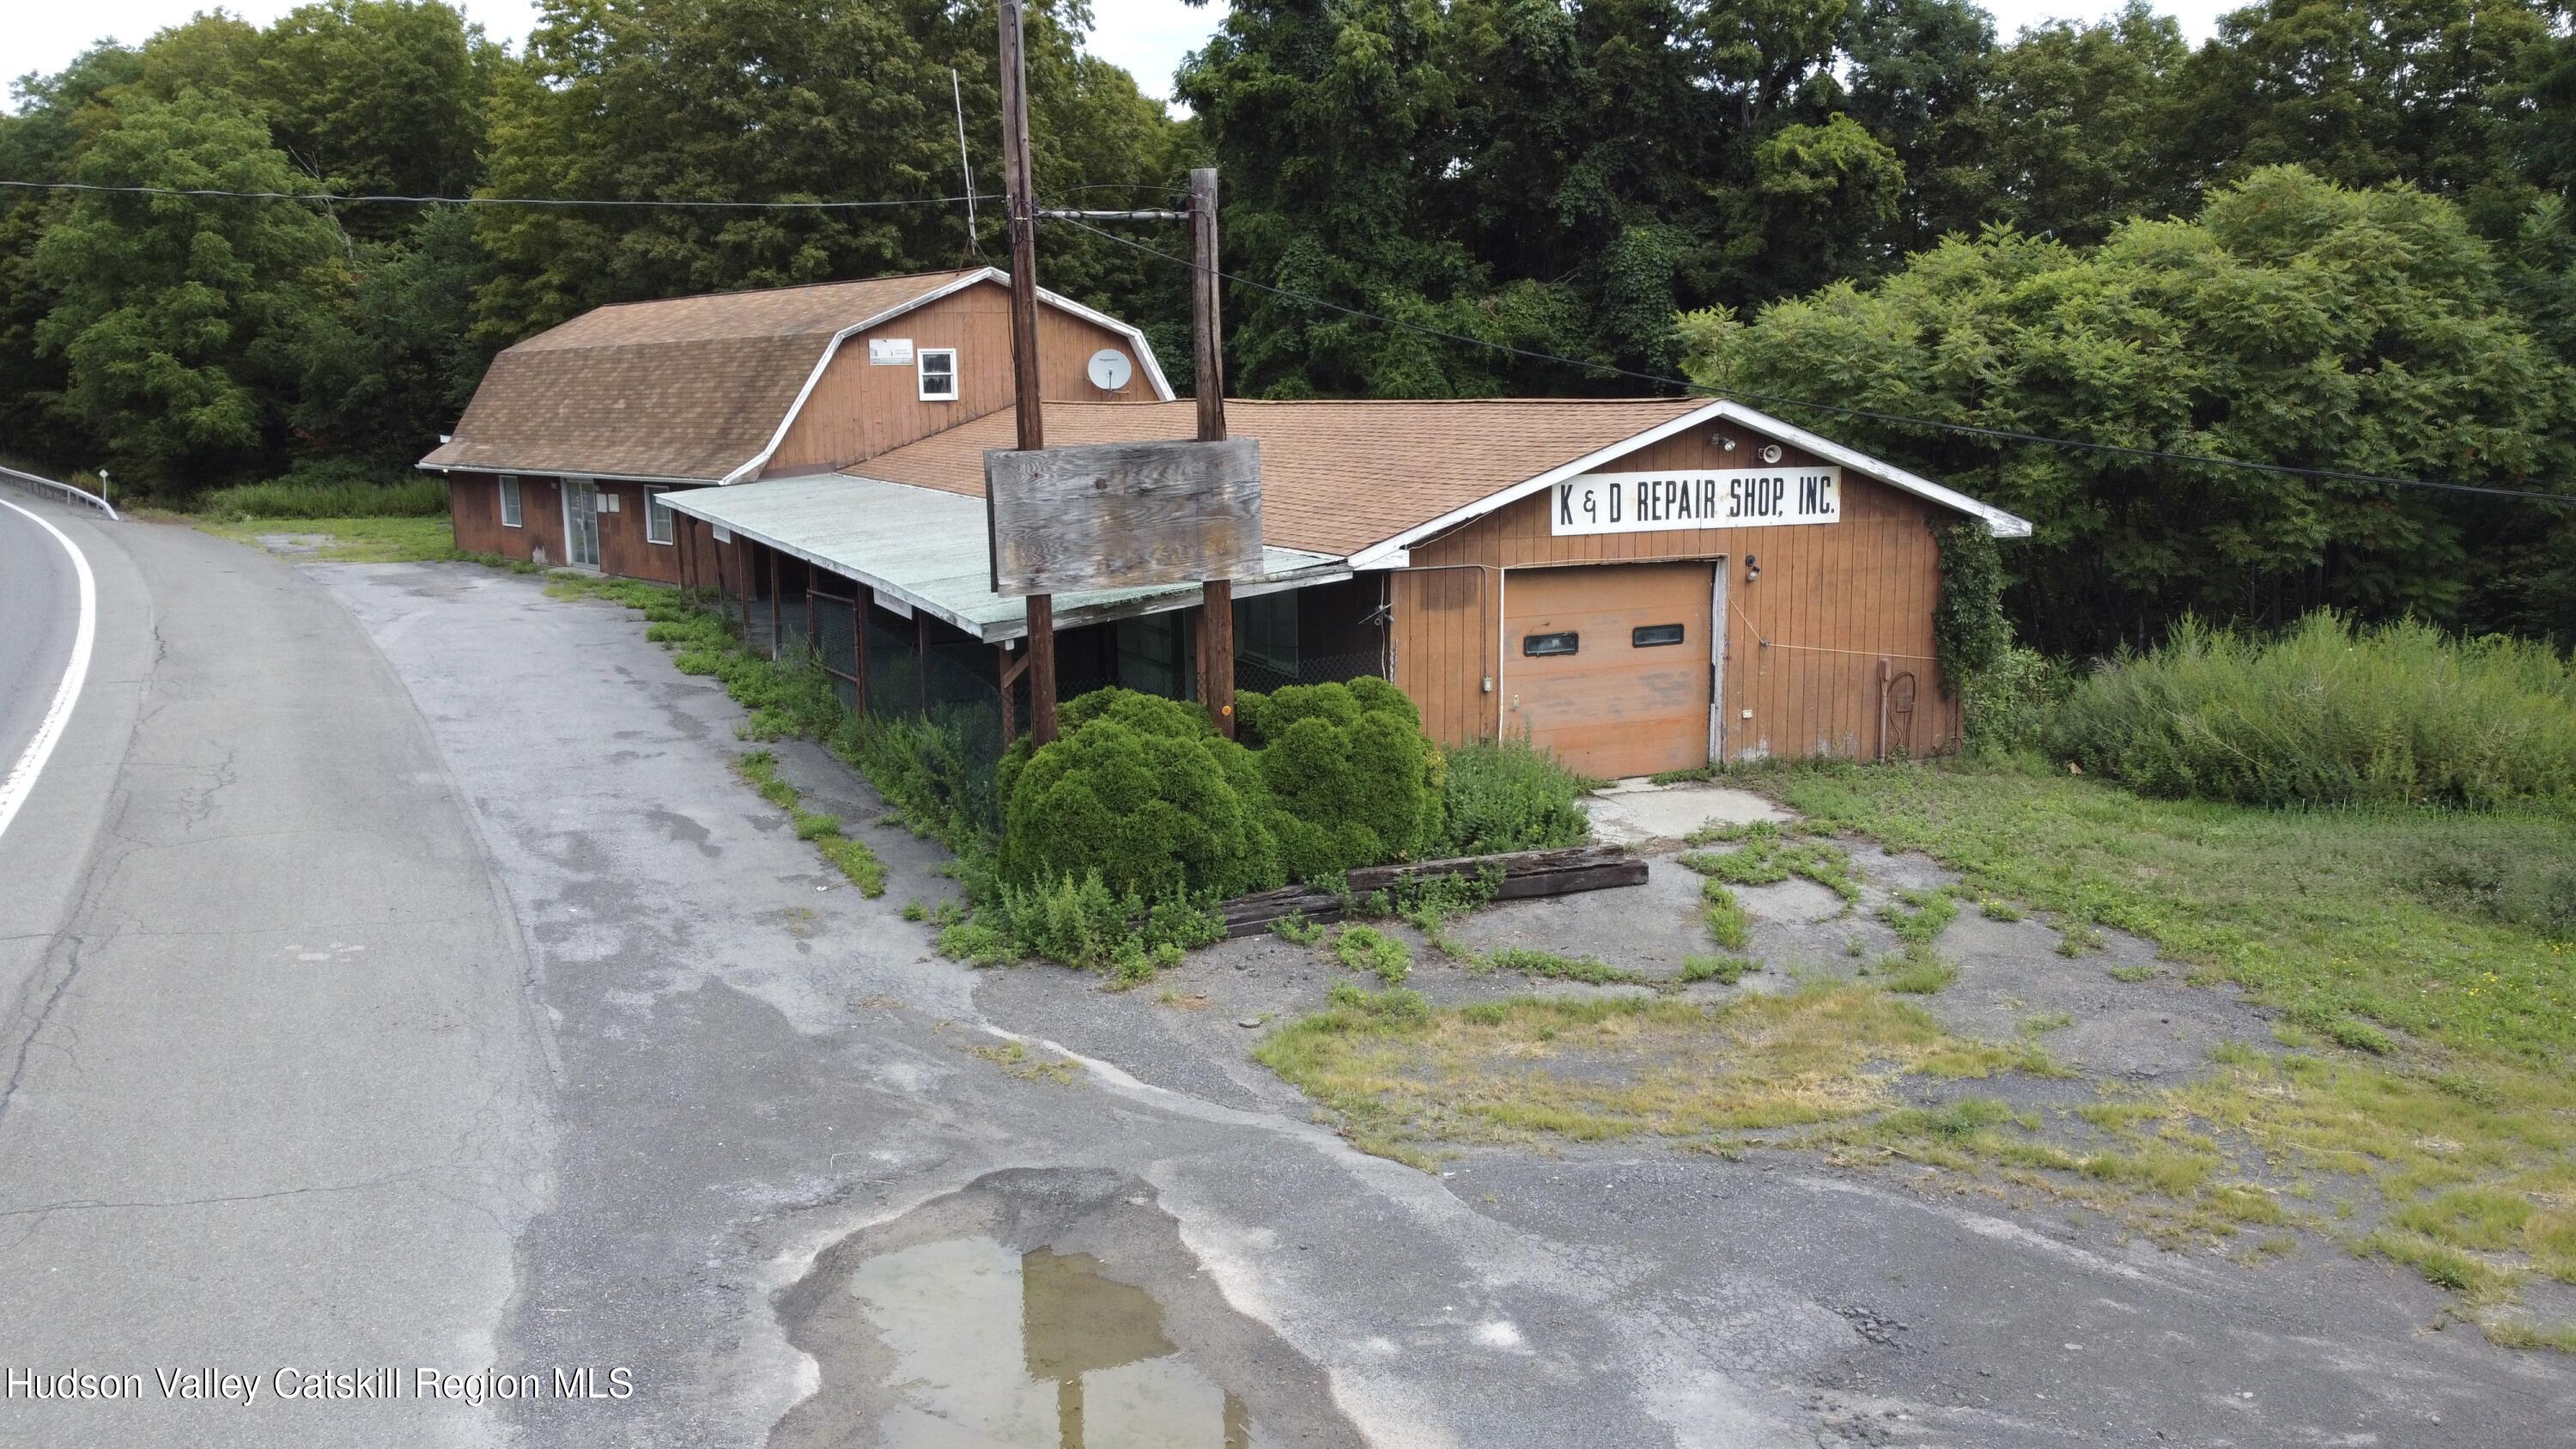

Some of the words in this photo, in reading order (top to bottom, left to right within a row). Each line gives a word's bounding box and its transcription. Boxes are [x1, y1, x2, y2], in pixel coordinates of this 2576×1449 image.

[1560, 484, 1573, 526] K
[1583, 489, 1596, 524] &
[1609, 483, 1621, 523] D
[1637, 478, 1716, 522] REPAIR
[1798, 475, 1835, 515] INC.
